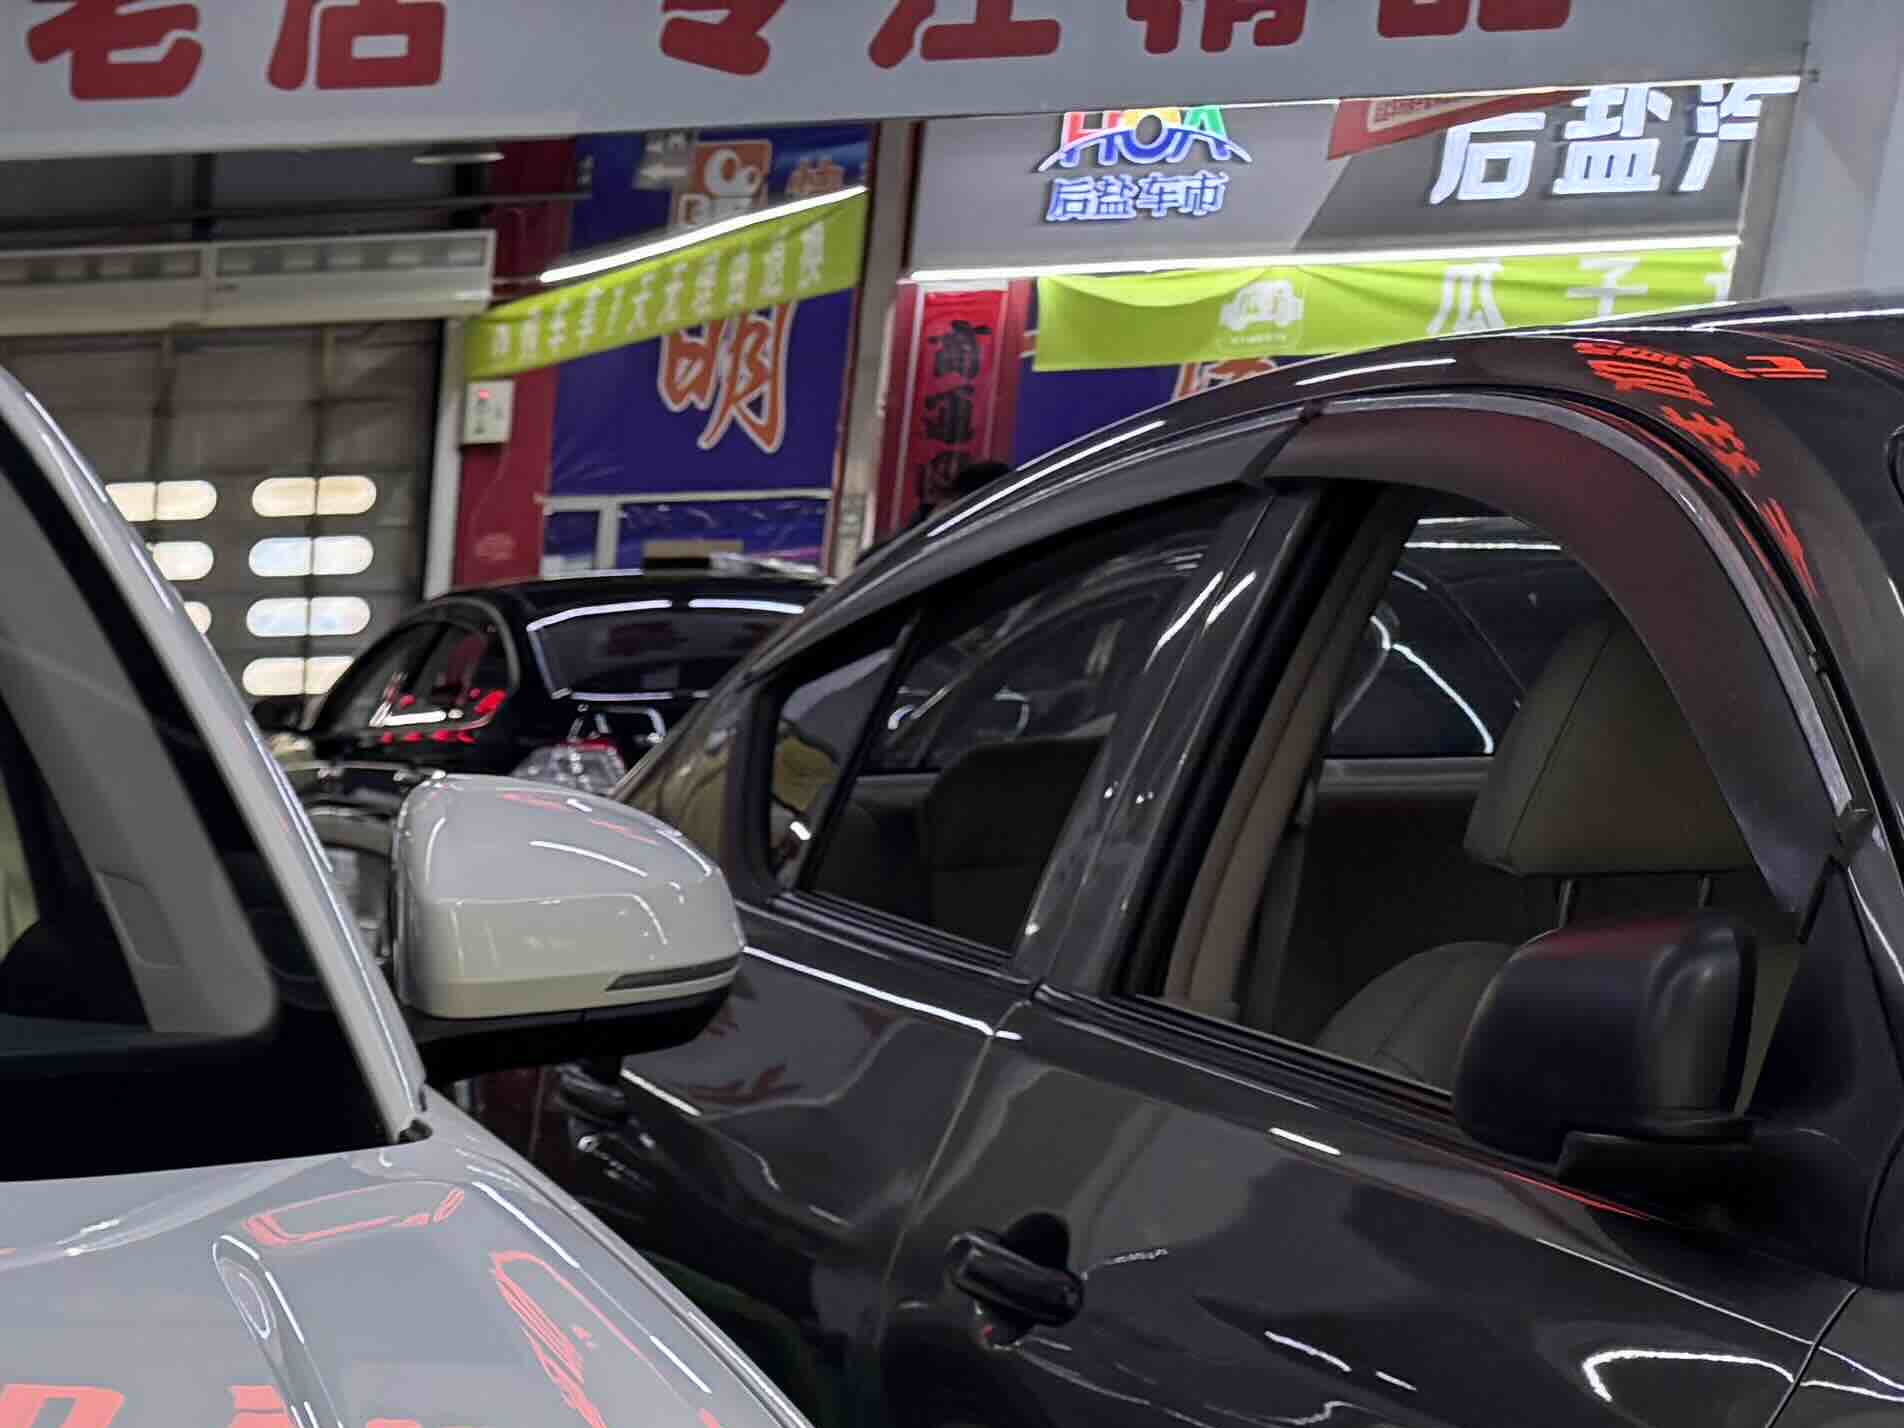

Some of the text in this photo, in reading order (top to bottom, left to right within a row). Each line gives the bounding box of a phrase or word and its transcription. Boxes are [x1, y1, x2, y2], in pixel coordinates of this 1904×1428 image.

[1045, 169, 1231, 222] 后盐车市
[1426, 243, 1738, 337] 瓜子
